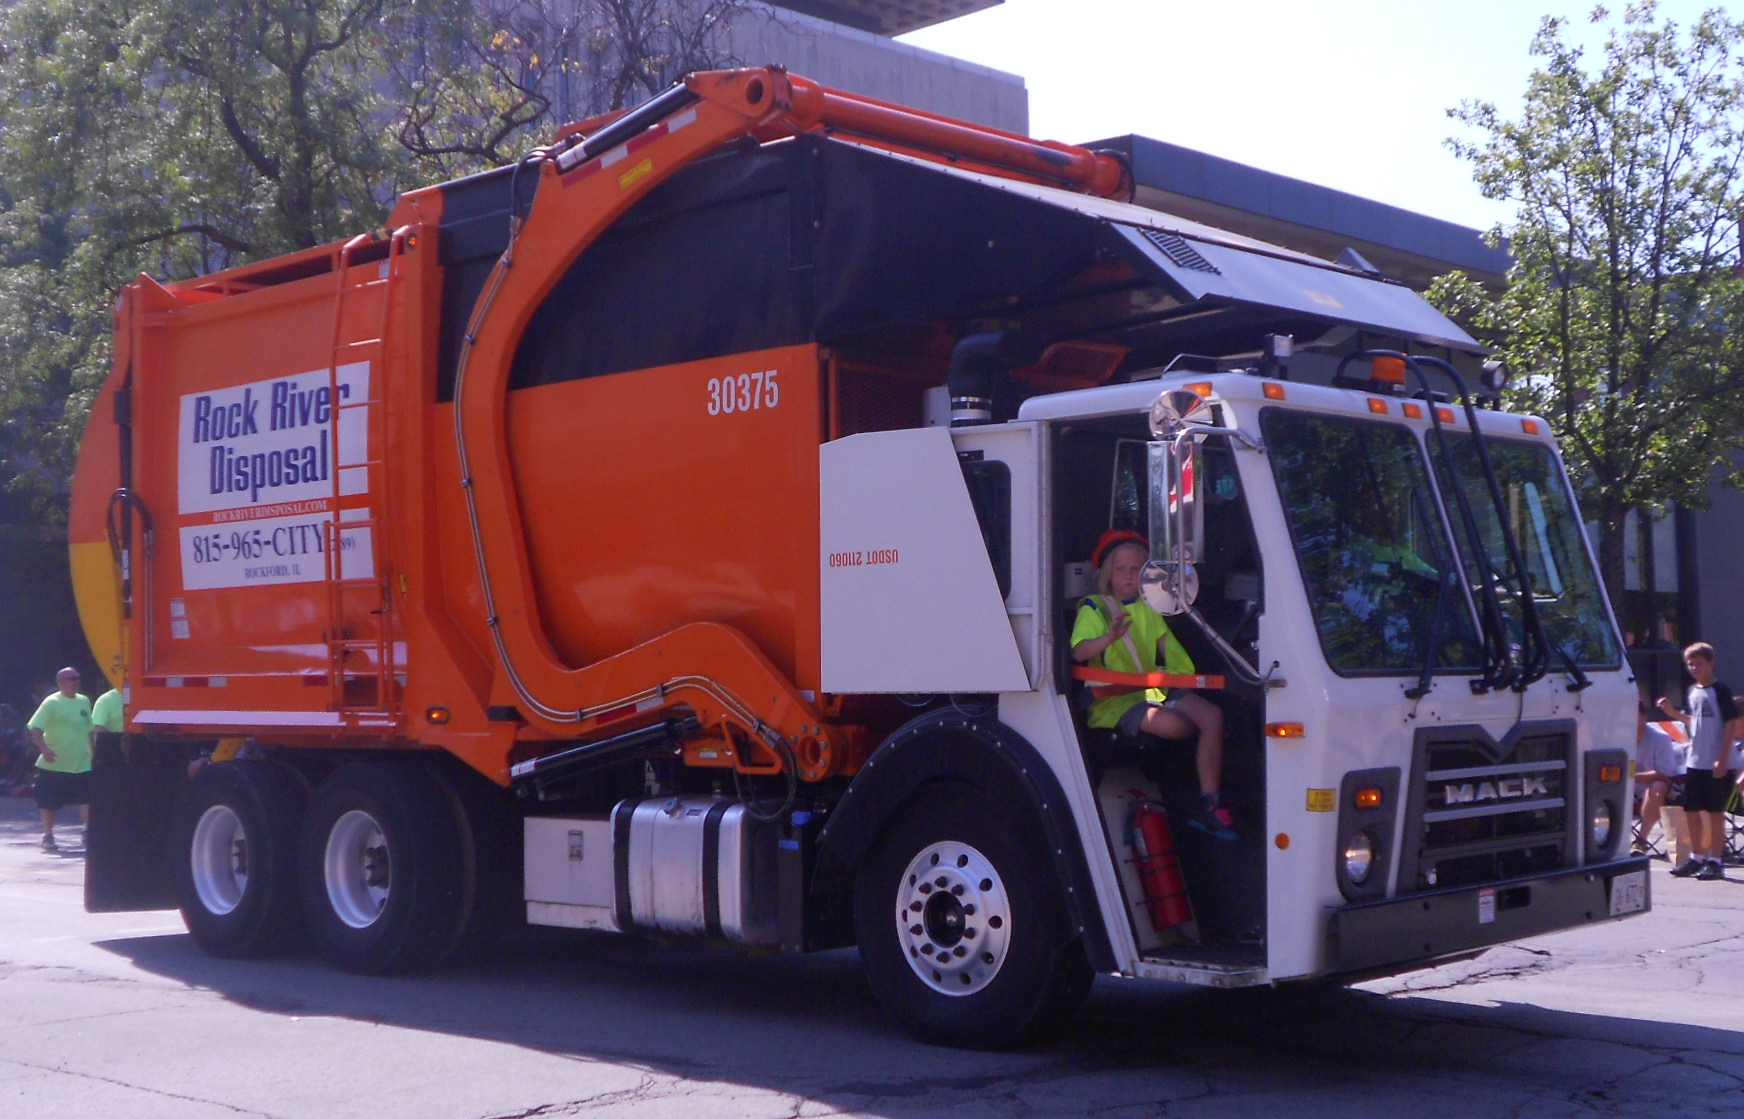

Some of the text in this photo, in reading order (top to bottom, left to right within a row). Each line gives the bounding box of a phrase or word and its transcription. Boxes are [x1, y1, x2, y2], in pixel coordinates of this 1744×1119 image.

[193, 381, 350, 443] Rock River
[707, 370, 780, 416] 30375
[210, 429, 328, 502] Disposal
[213, 499, 327, 523] ROCKRIVERDISPOSAL.COM
[193, 523, 325, 564] 815-965-CITY
[829, 549, 898, 567] USDOT 211060
[1445, 777, 1548, 804] MACK
